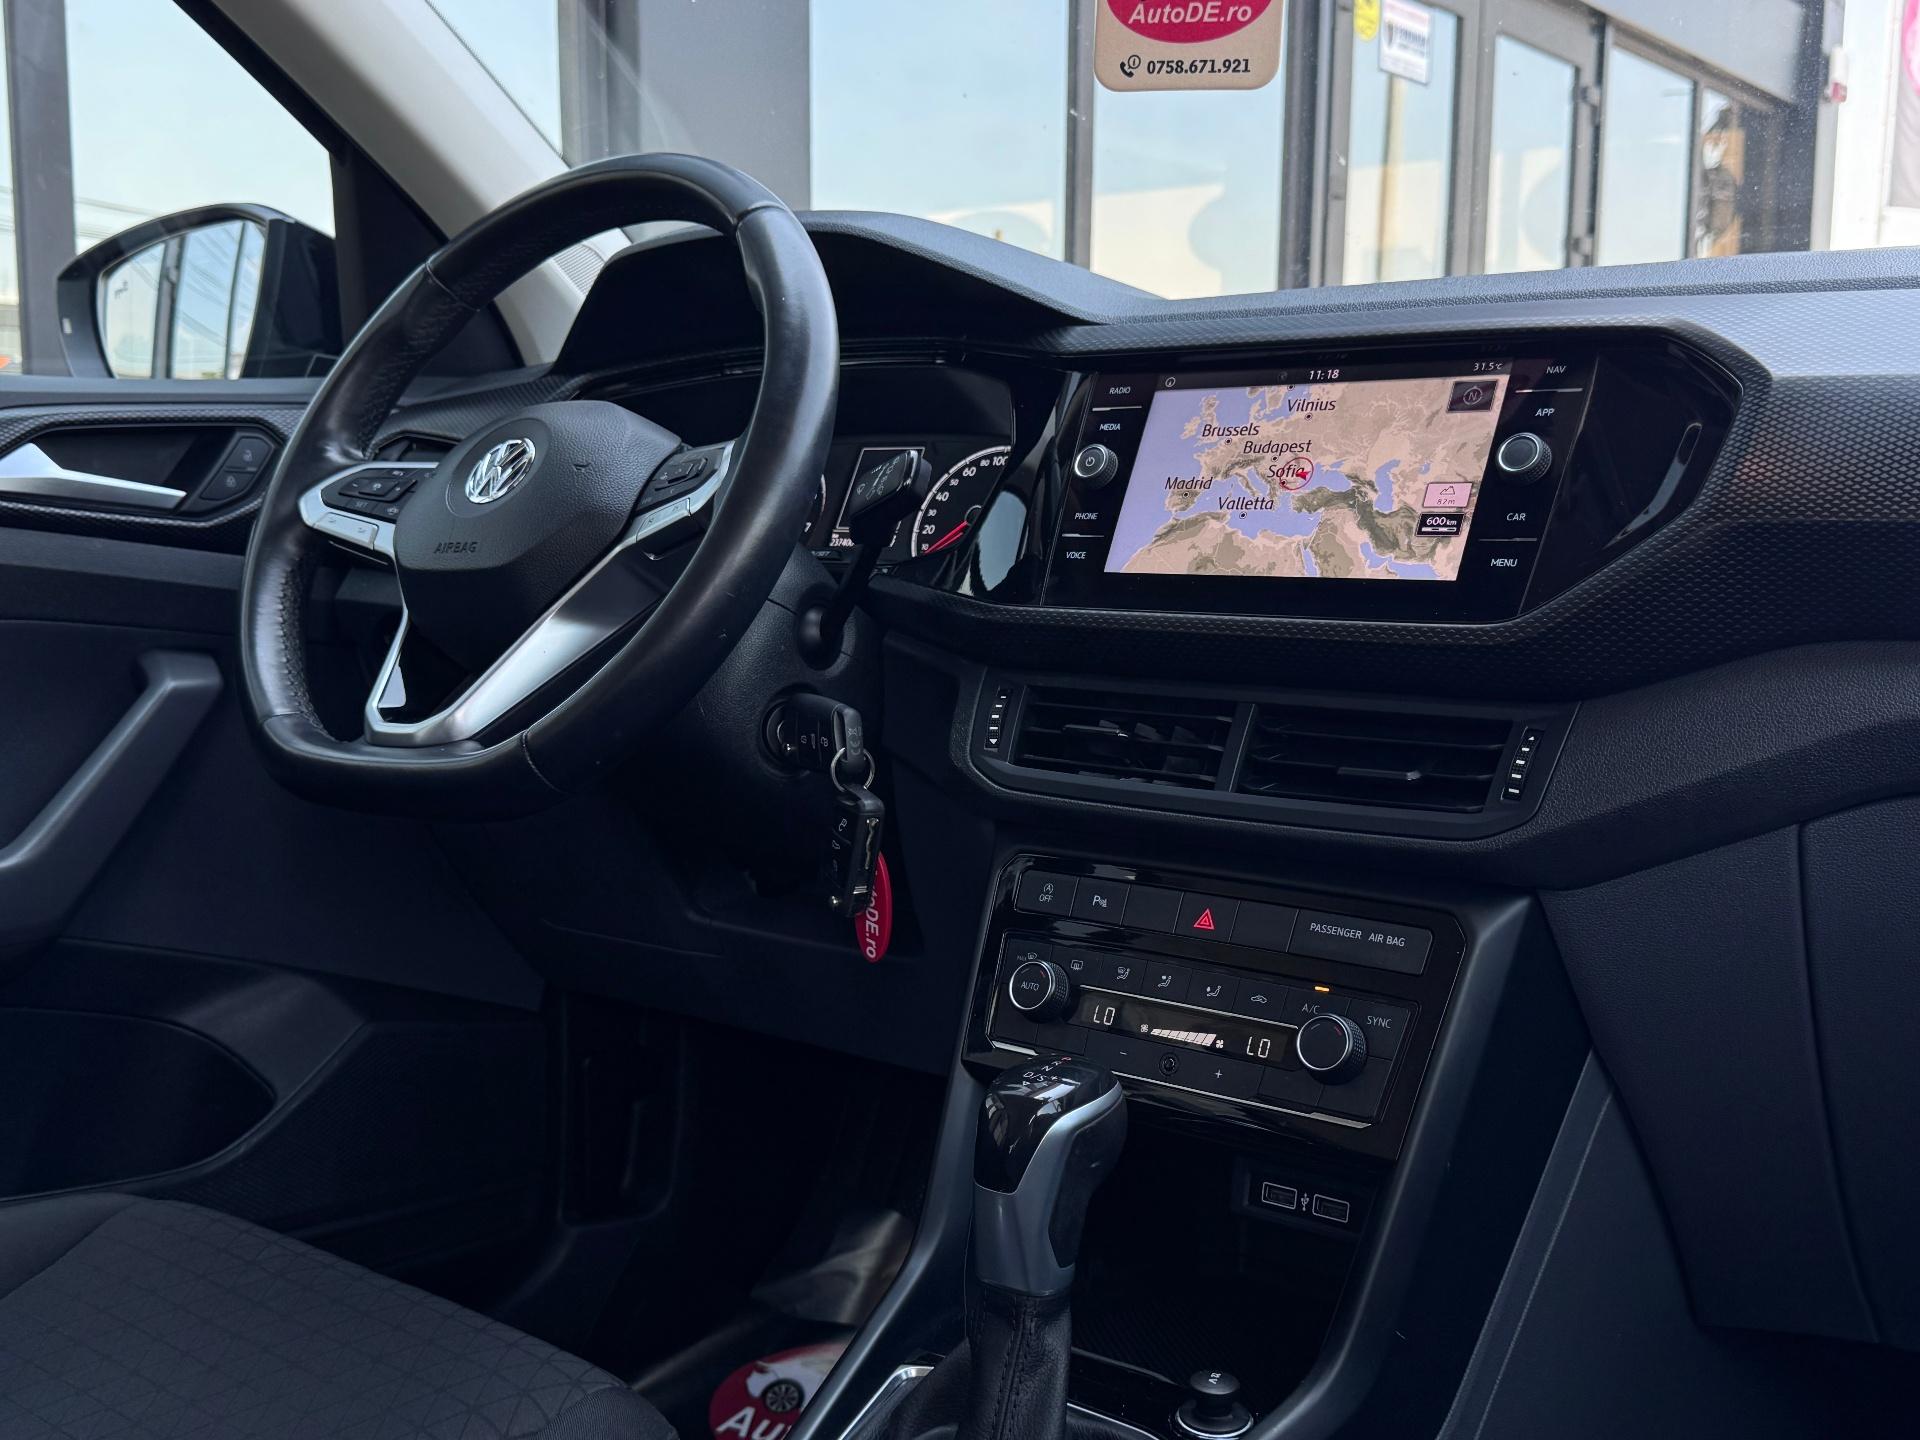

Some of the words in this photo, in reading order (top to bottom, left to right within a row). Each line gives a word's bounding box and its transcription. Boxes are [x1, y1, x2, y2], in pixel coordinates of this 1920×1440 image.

[1128, 2, 1251, 25] AutoDE.ro
[1146, 58, 1251, 75] 0758.671.921
[1309, 369, 1340, 380] 11:18
[1546, 365, 1566, 374] NAV
[1109, 386, 1131, 395] RADIO
[1287, 398, 1337, 412] Vilnius
[1534, 408, 1555, 417] APP
[1099, 423, 1121, 431] MEDIA
[1201, 422, 1260, 437] Brussels
[1243, 439, 1313, 456] Budapest
[962, 467, 977, 477] 60
[1164, 476, 1213, 490] Madrid
[936, 492, 949, 502] 40
[1218, 496, 1274, 510] Valletta
[927, 509, 937, 517] 30
[1074, 512, 1098, 520] PHONE
[1506, 512, 1526, 521] CAR
[922, 525, 936, 535] 20
[433, 541, 479, 554] AIRBAG
[1066, 551, 1087, 559] VOICE
[1490, 558, 1518, 567] MENU
[1038, 894, 1054, 903] OFF
[1310, 922, 1362, 940] PASSENGER
[1368, 932, 1383, 943] AIR
[1386, 935, 1406, 947] BAG
[1020, 981, 1040, 992] AUTO
[1301, 1003, 1320, 1015] A/C
[1093, 1004, 1116, 1026] LO
[1367, 1015, 1392, 1029] SYNC
[1246, 1036, 1271, 1059] LO
